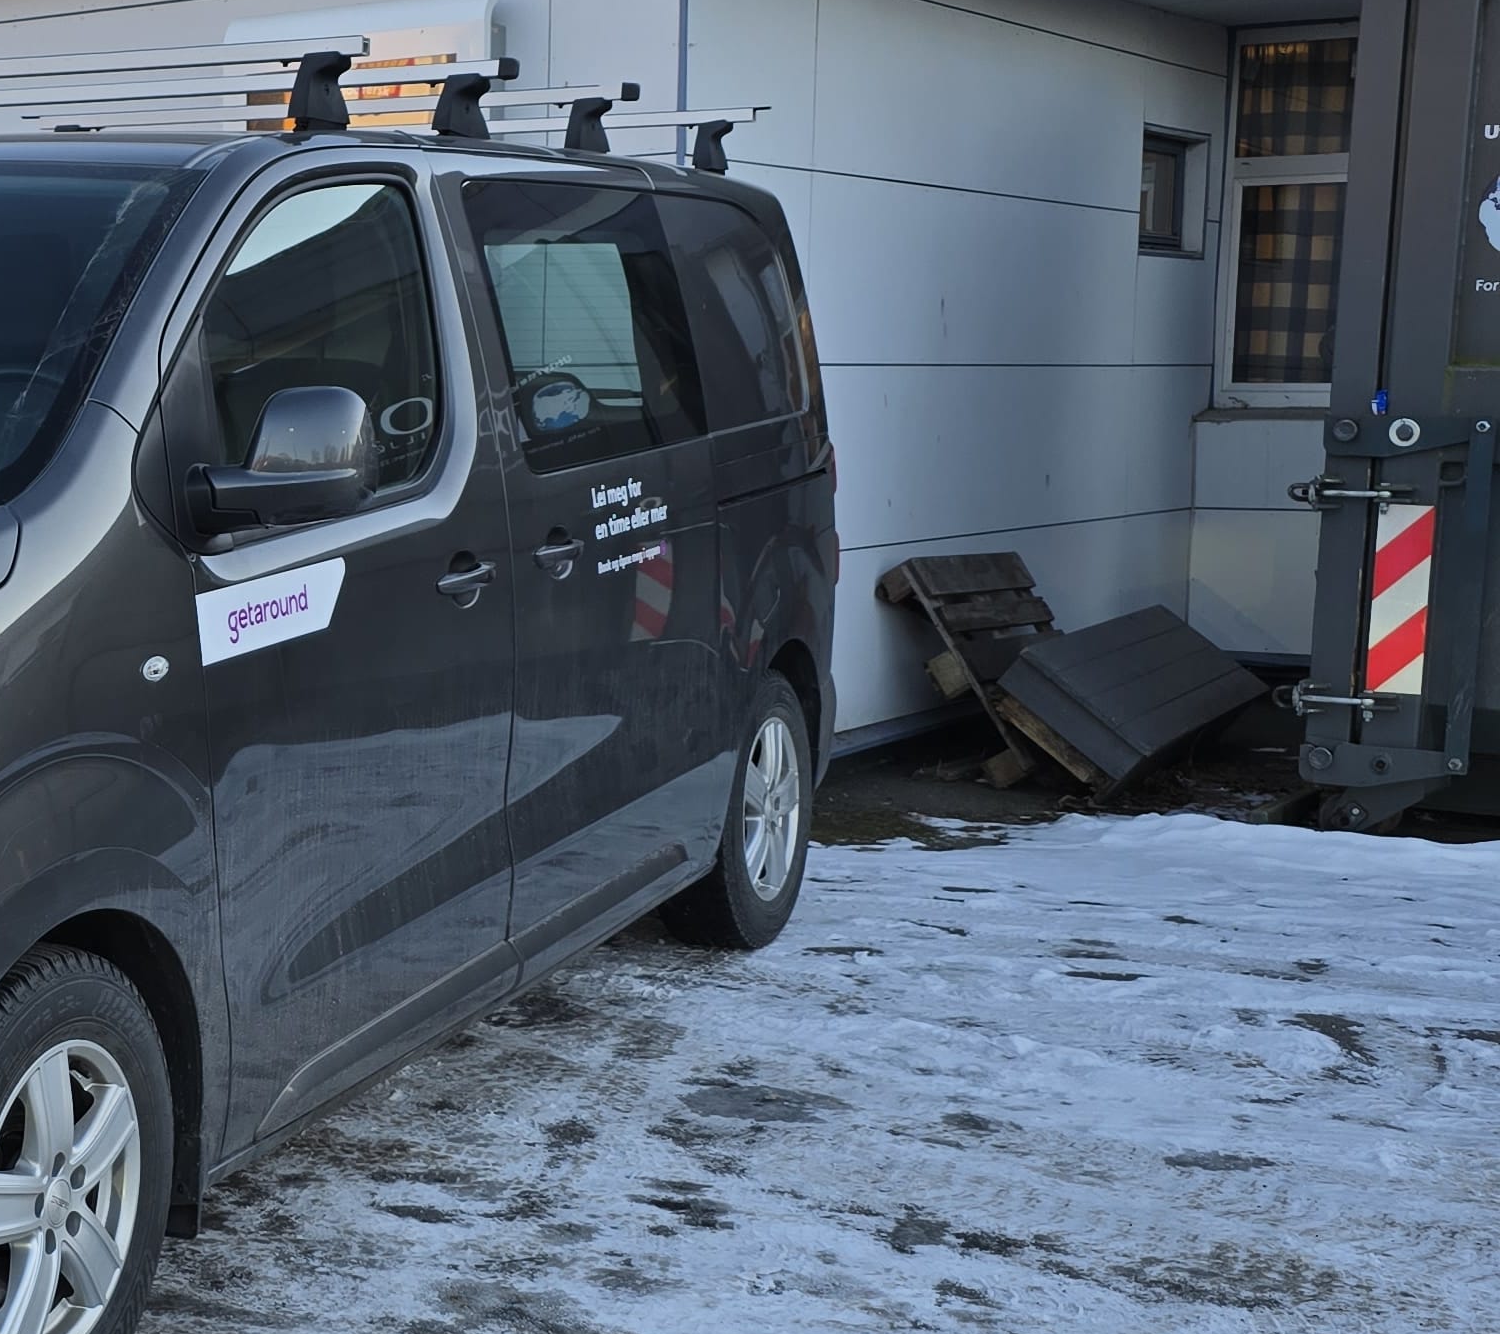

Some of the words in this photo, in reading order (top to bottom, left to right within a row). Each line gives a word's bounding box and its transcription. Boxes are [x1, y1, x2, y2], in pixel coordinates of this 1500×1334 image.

[1484, 124, 1500, 140] U
[1475, 279, 1500, 292] For
[591, 484, 607, 508] Lei
[606, 485, 628, 507] meg
[627, 477, 642, 498] for
[595, 523, 609, 540] en
[608, 513, 631, 536] time
[630, 507, 650, 529] eller
[650, 505, 668, 523] mer
[227, 583, 309, 644] getaround
